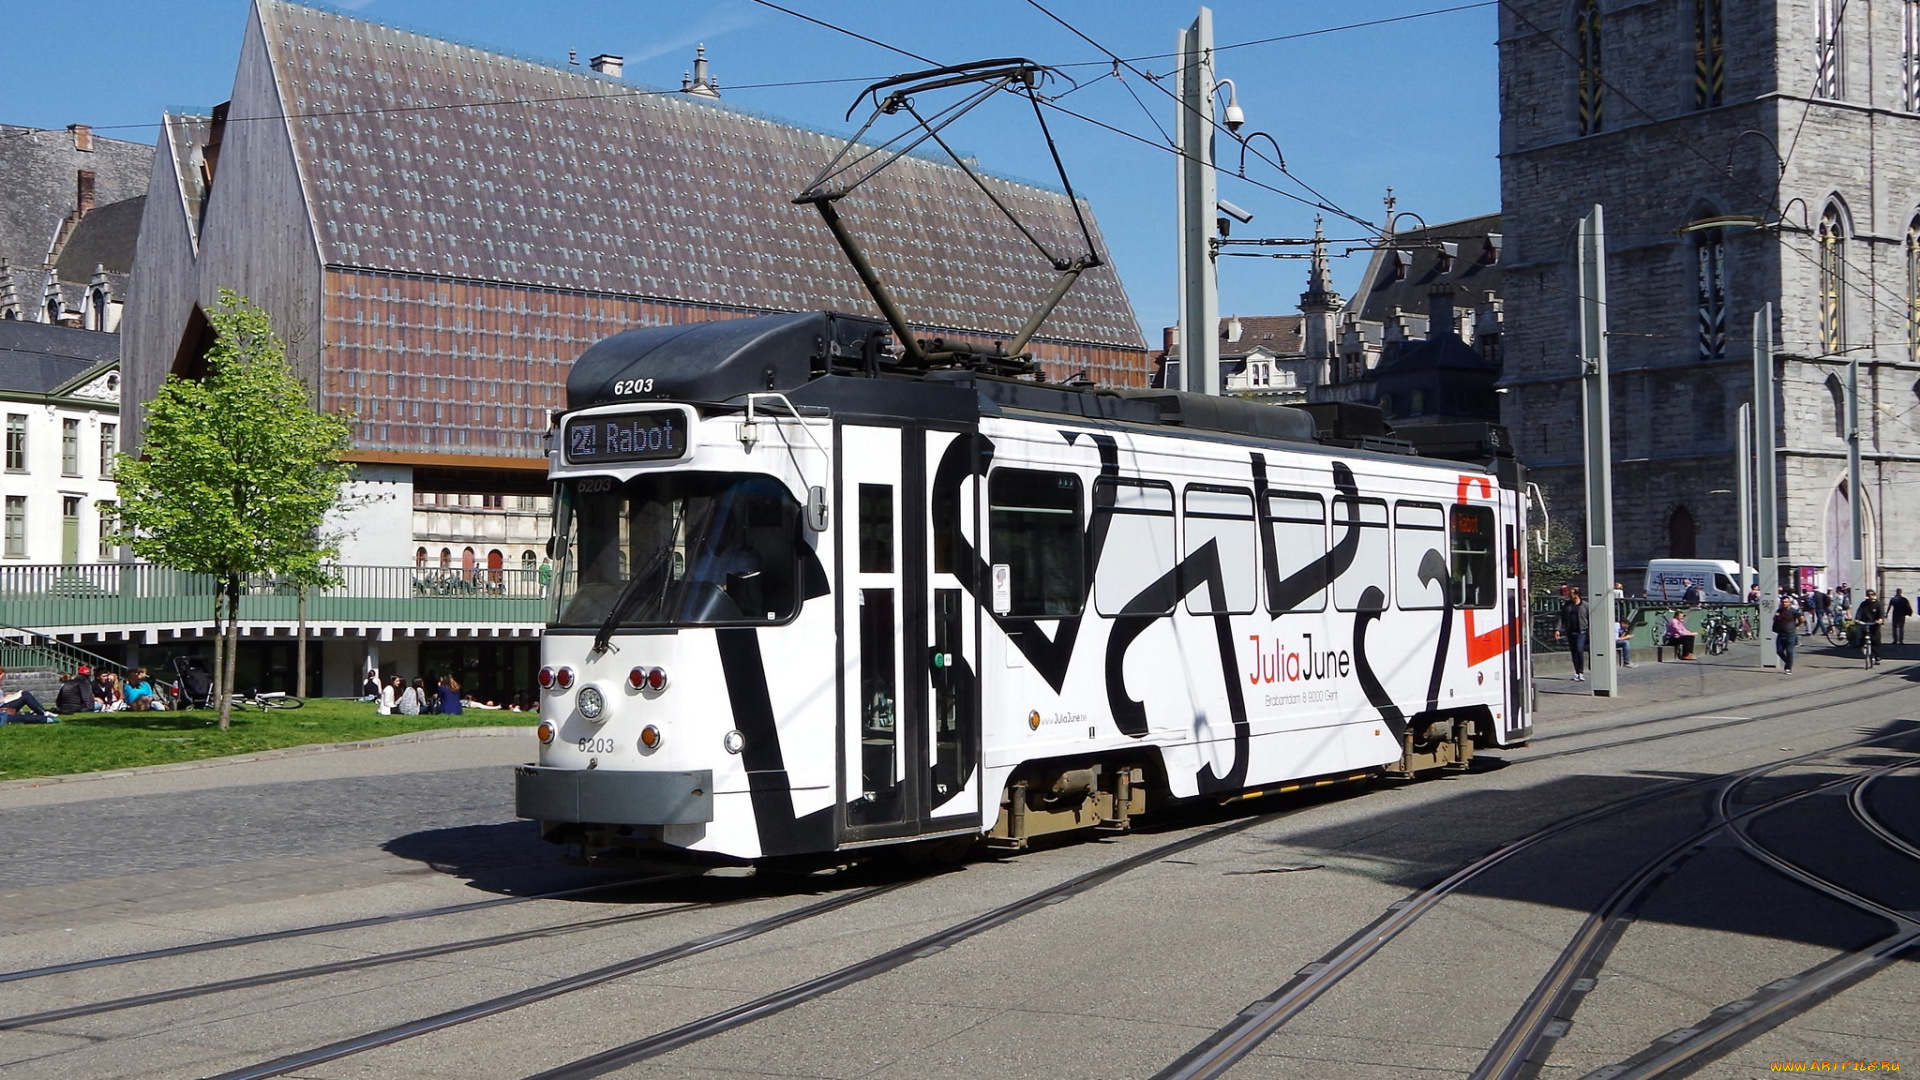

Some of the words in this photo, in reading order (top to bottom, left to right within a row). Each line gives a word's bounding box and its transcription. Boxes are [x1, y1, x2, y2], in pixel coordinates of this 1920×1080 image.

[614, 379, 654, 396] 6203
[572, 425, 596, 455] 24
[606, 419, 673, 454] Rabot
[577, 478, 612, 493] 6203
[578, 738, 614, 754] 6203
